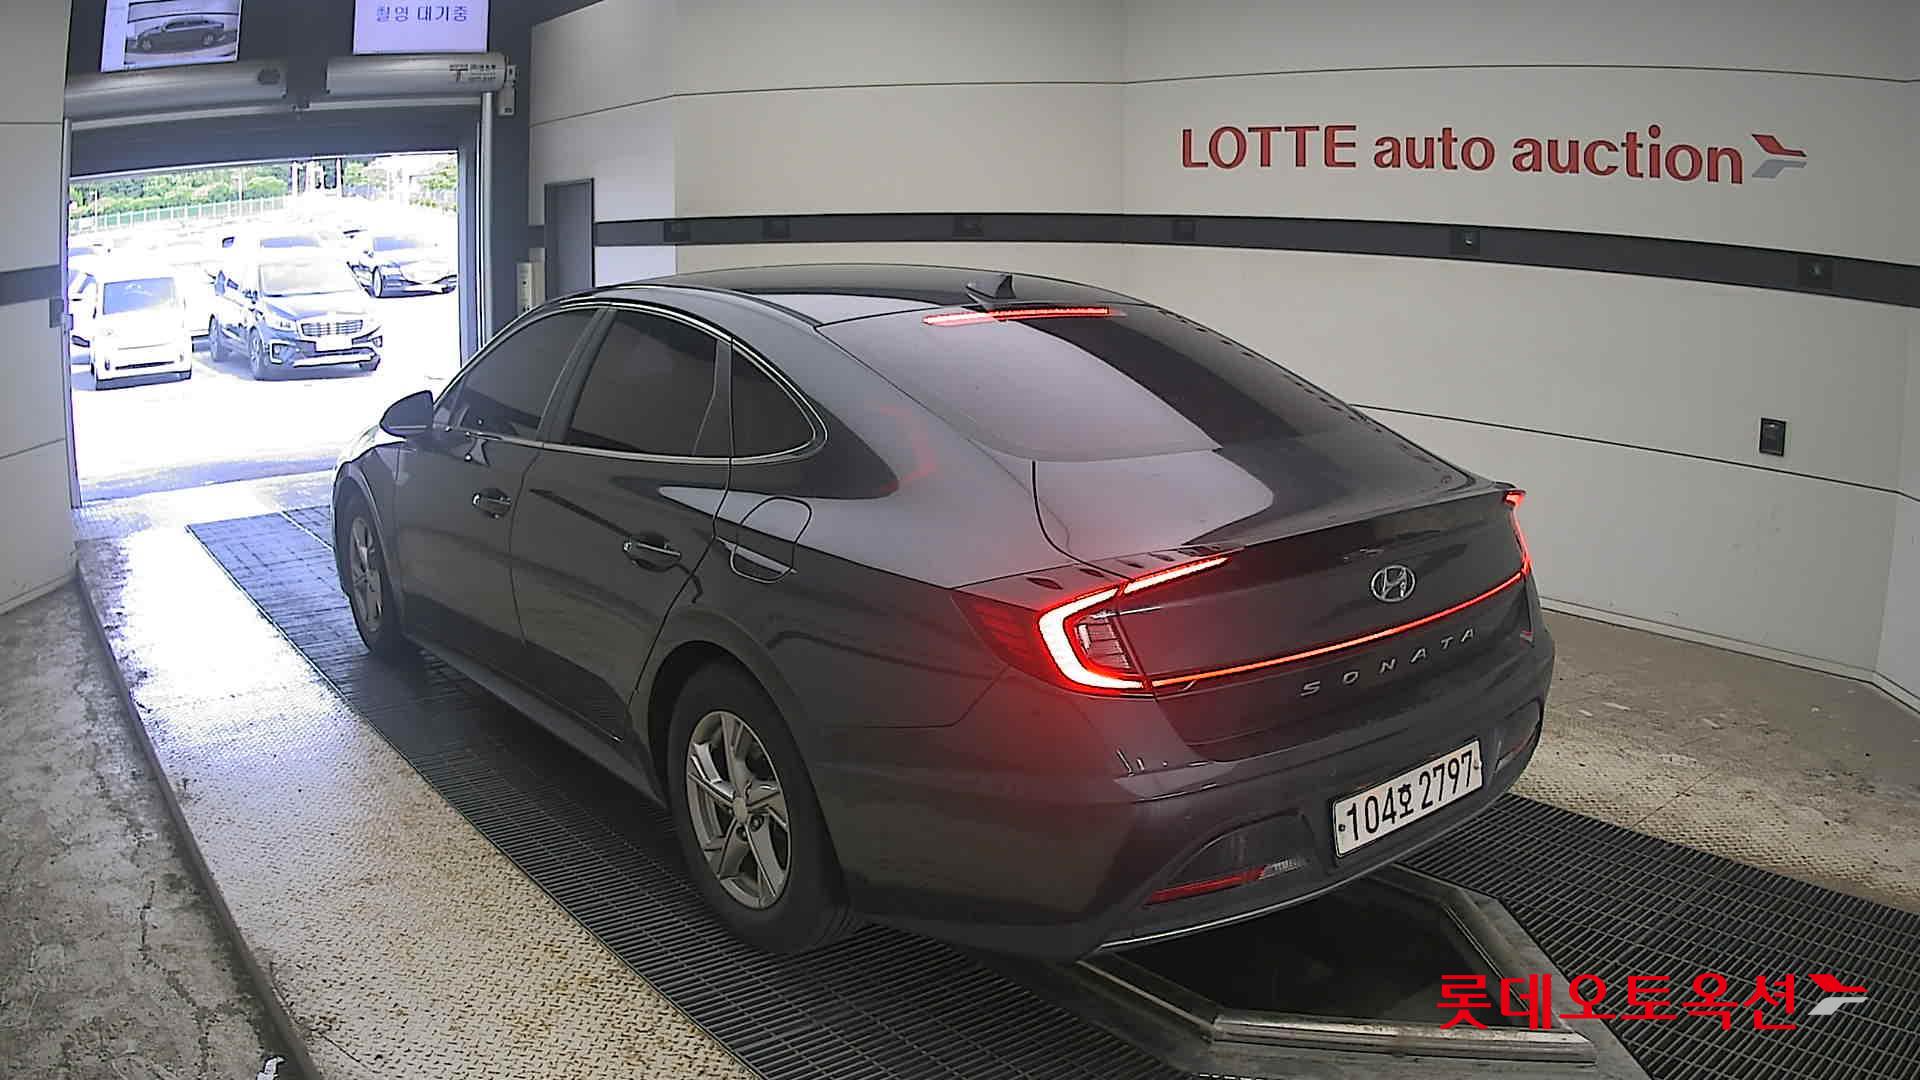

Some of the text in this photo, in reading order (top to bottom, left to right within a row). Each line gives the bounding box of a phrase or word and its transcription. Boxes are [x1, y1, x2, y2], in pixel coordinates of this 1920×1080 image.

[416, 5, 468, 22] 대기중
[1182, 123, 1744, 185] LOTTE auto auction
[1300, 627, 1475, 697] SONATA
[1418, 749, 1474, 810] 2797
